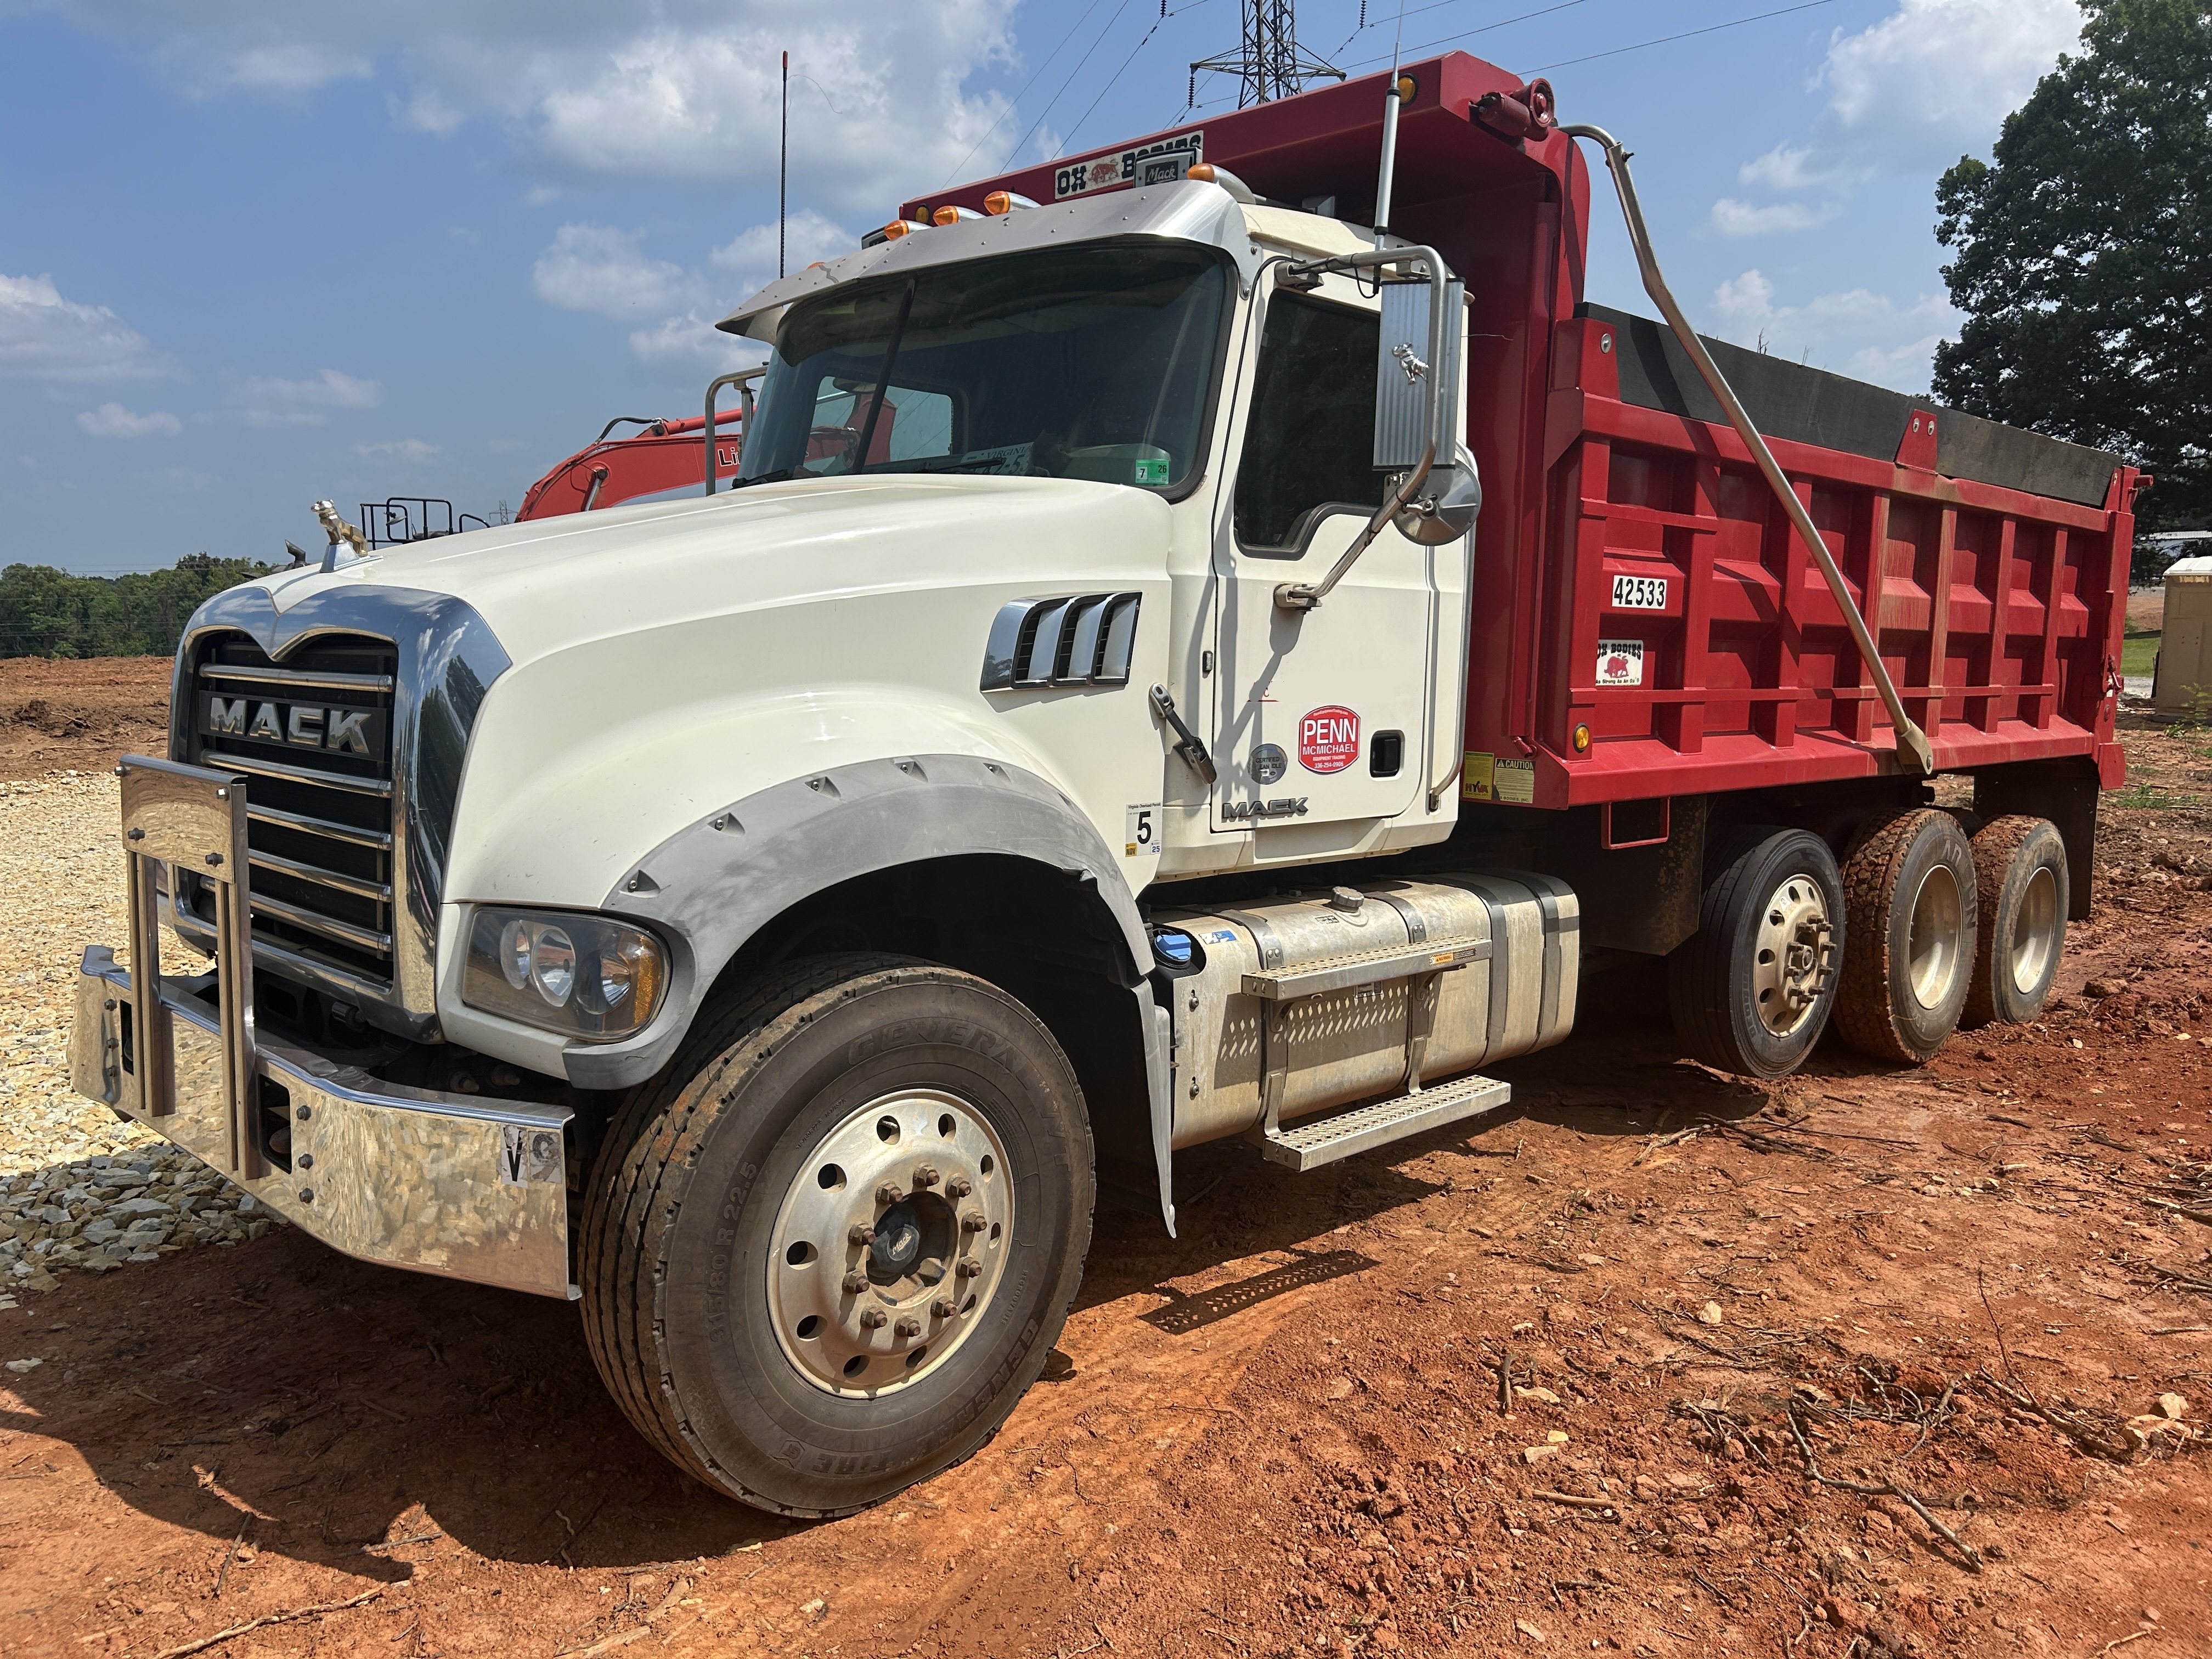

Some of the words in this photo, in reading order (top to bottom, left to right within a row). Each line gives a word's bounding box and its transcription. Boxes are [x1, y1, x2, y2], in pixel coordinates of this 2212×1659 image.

[1057, 166, 1086, 195] OX
[1147, 165, 1176, 182] Mack
[1140, 468, 1146, 478] 7
[1158, 465, 1167, 473] 26
[1614, 578, 1665, 607] 42533
[1611, 644, 1641, 660] BODIES
[210, 697, 372, 754] MACK
[1303, 718, 1357, 745] PENN
[1302, 743, 1356, 755] MCMICHAEL
[1222, 797, 1309, 819] MACK
[1137, 810, 1152, 844] 5
[848, 1020, 1029, 1091] GENERAL
[723, 1161, 757, 1221] 22.5
[892, 1232, 912, 1256] Mack
